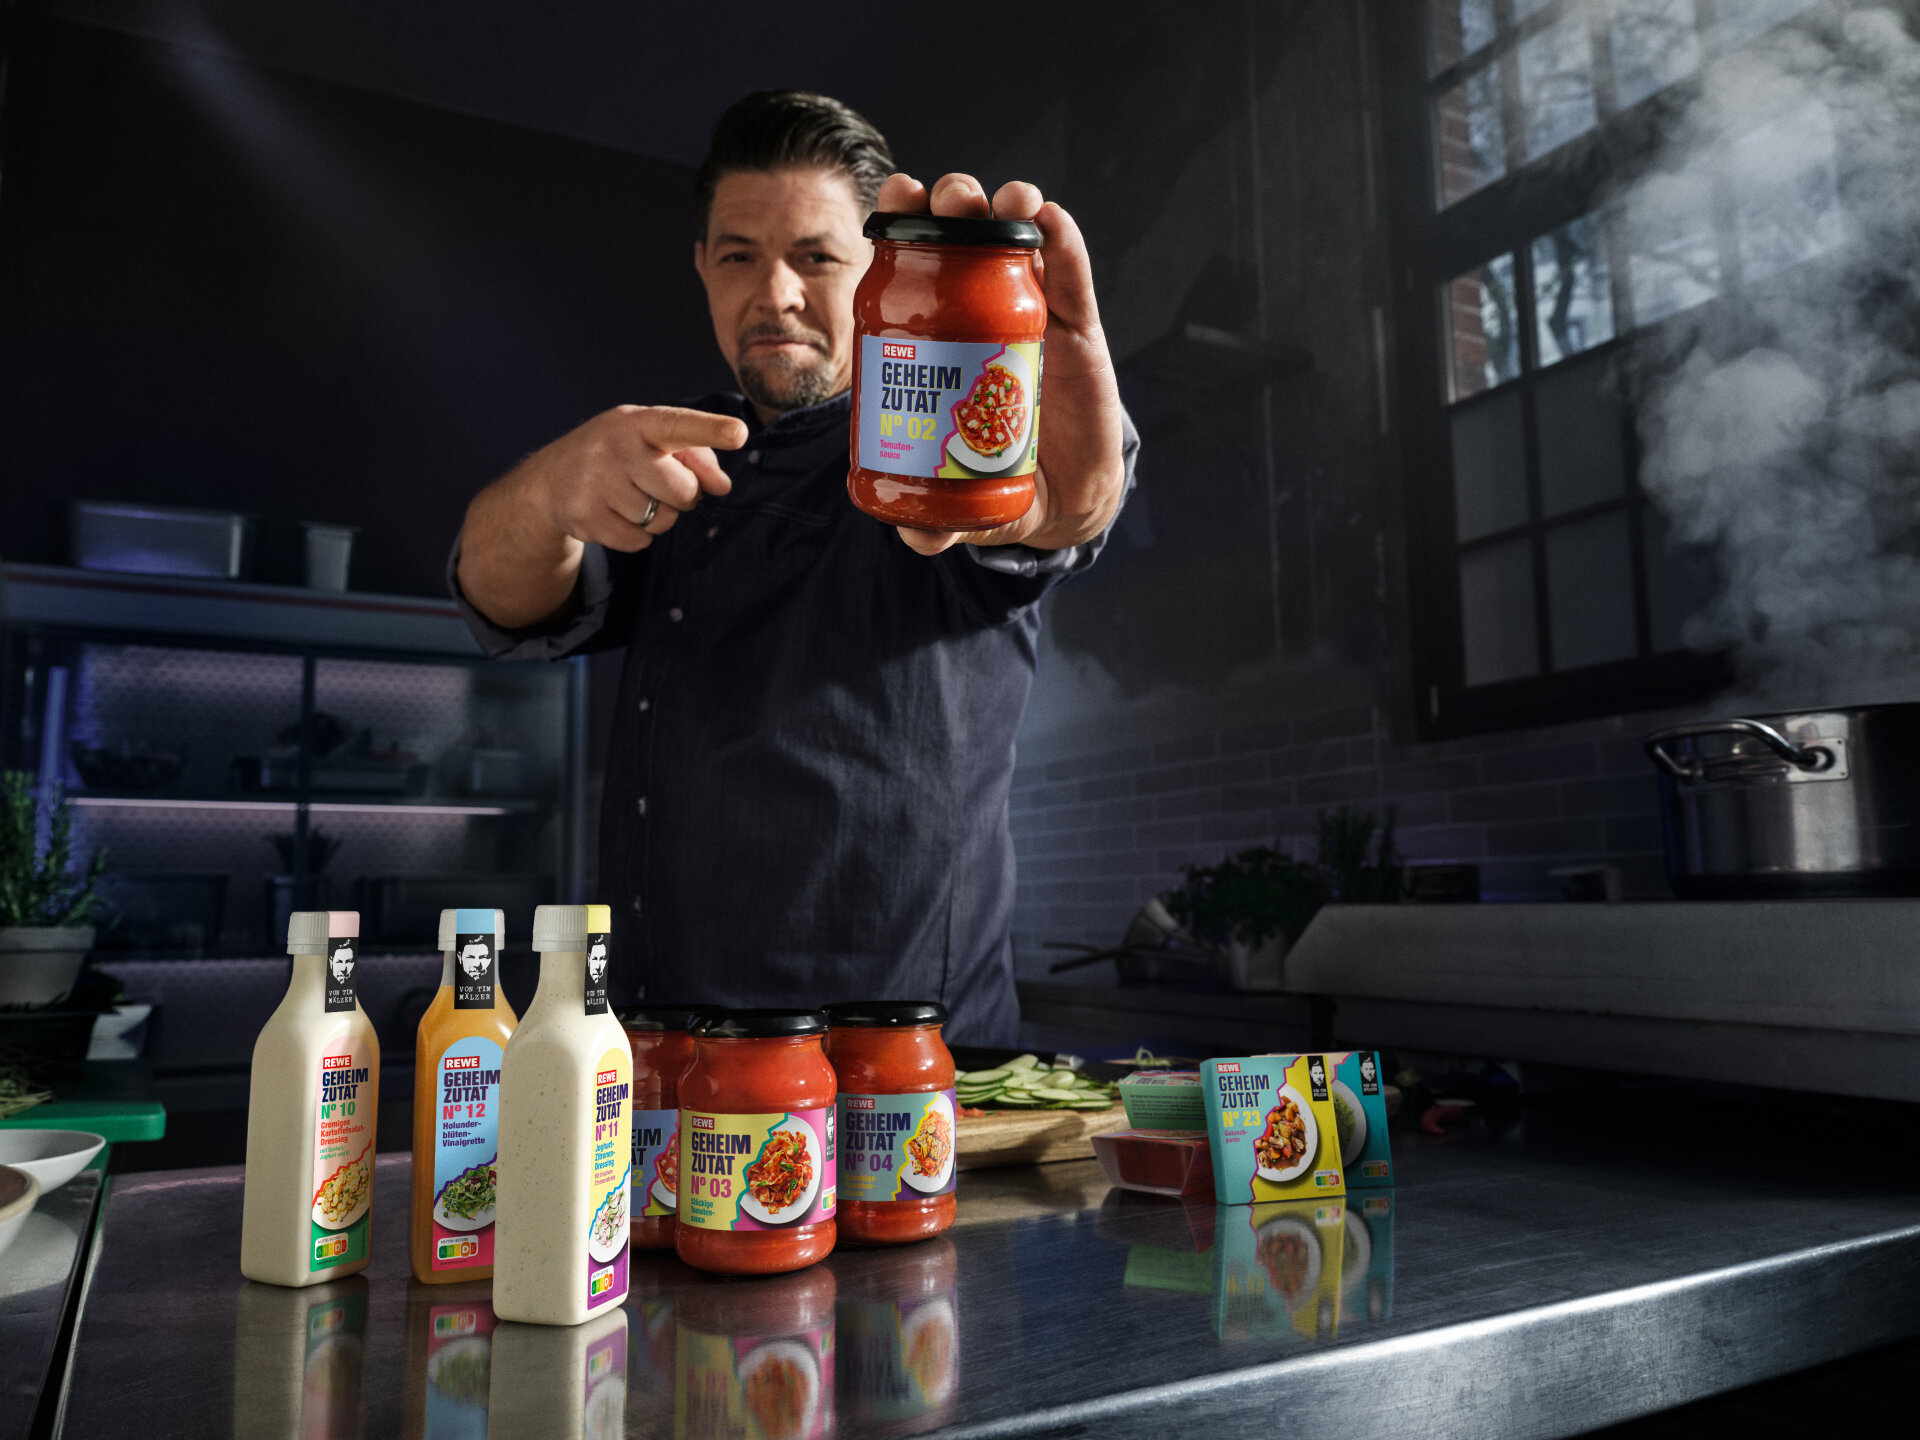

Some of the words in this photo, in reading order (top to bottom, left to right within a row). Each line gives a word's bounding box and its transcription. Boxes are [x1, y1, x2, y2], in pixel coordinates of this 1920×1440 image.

[884, 345, 914, 358] REWE
[882, 362, 962, 390] GEHEIM
[881, 386, 942, 414] ZUTAT
[908, 417, 936, 440] 02
[880, 440, 914, 451] Tomaten-
[880, 450, 901, 460] sauce
[459, 992, 491, 1000] MÄLZER
[324, 1057, 350, 1068] REWE
[446, 1058, 478, 1068] REWE
[1218, 1064, 1240, 1072] REWE
[322, 1068, 368, 1087] GEHEIM
[444, 1070, 501, 1087] GEHEIM
[598, 1071, 616, 1085] REWE
[1218, 1074, 1271, 1092] GEHEIM
[322, 1084, 358, 1102] ZUTAT
[443, 1086, 489, 1103] ZUTAT
[596, 1083, 629, 1106] GEHEIM
[1221, 1091, 1260, 1109] ZUTAT
[340, 1101, 356, 1117] 10
[466, 1103, 486, 1118] 12
[596, 1101, 621, 1123] ZUTAT
[847, 1099, 874, 1109] REWE
[321, 1120, 350, 1130] Cremiges
[443, 1121, 481, 1130] Holunder-
[692, 1117, 714, 1129] REWE
[845, 1111, 911, 1131] GEHEIM
[1242, 1110, 1261, 1126] 23
[442, 1131, 471, 1139] blüten-
[608, 1120, 618, 1138] 11
[632, 1128, 662, 1147] EIM
[320, 1136, 349, 1145] Dressing
[442, 1137, 486, 1147] Vinaigrette
[691, 1131, 751, 1154] GEHEIM
[846, 1131, 896, 1151] ZUTAT
[691, 1152, 735, 1175] ZUTAT
[870, 1153, 893, 1172] 04
[632, 1169, 643, 1187] 2
[710, 1178, 731, 1198] 03
